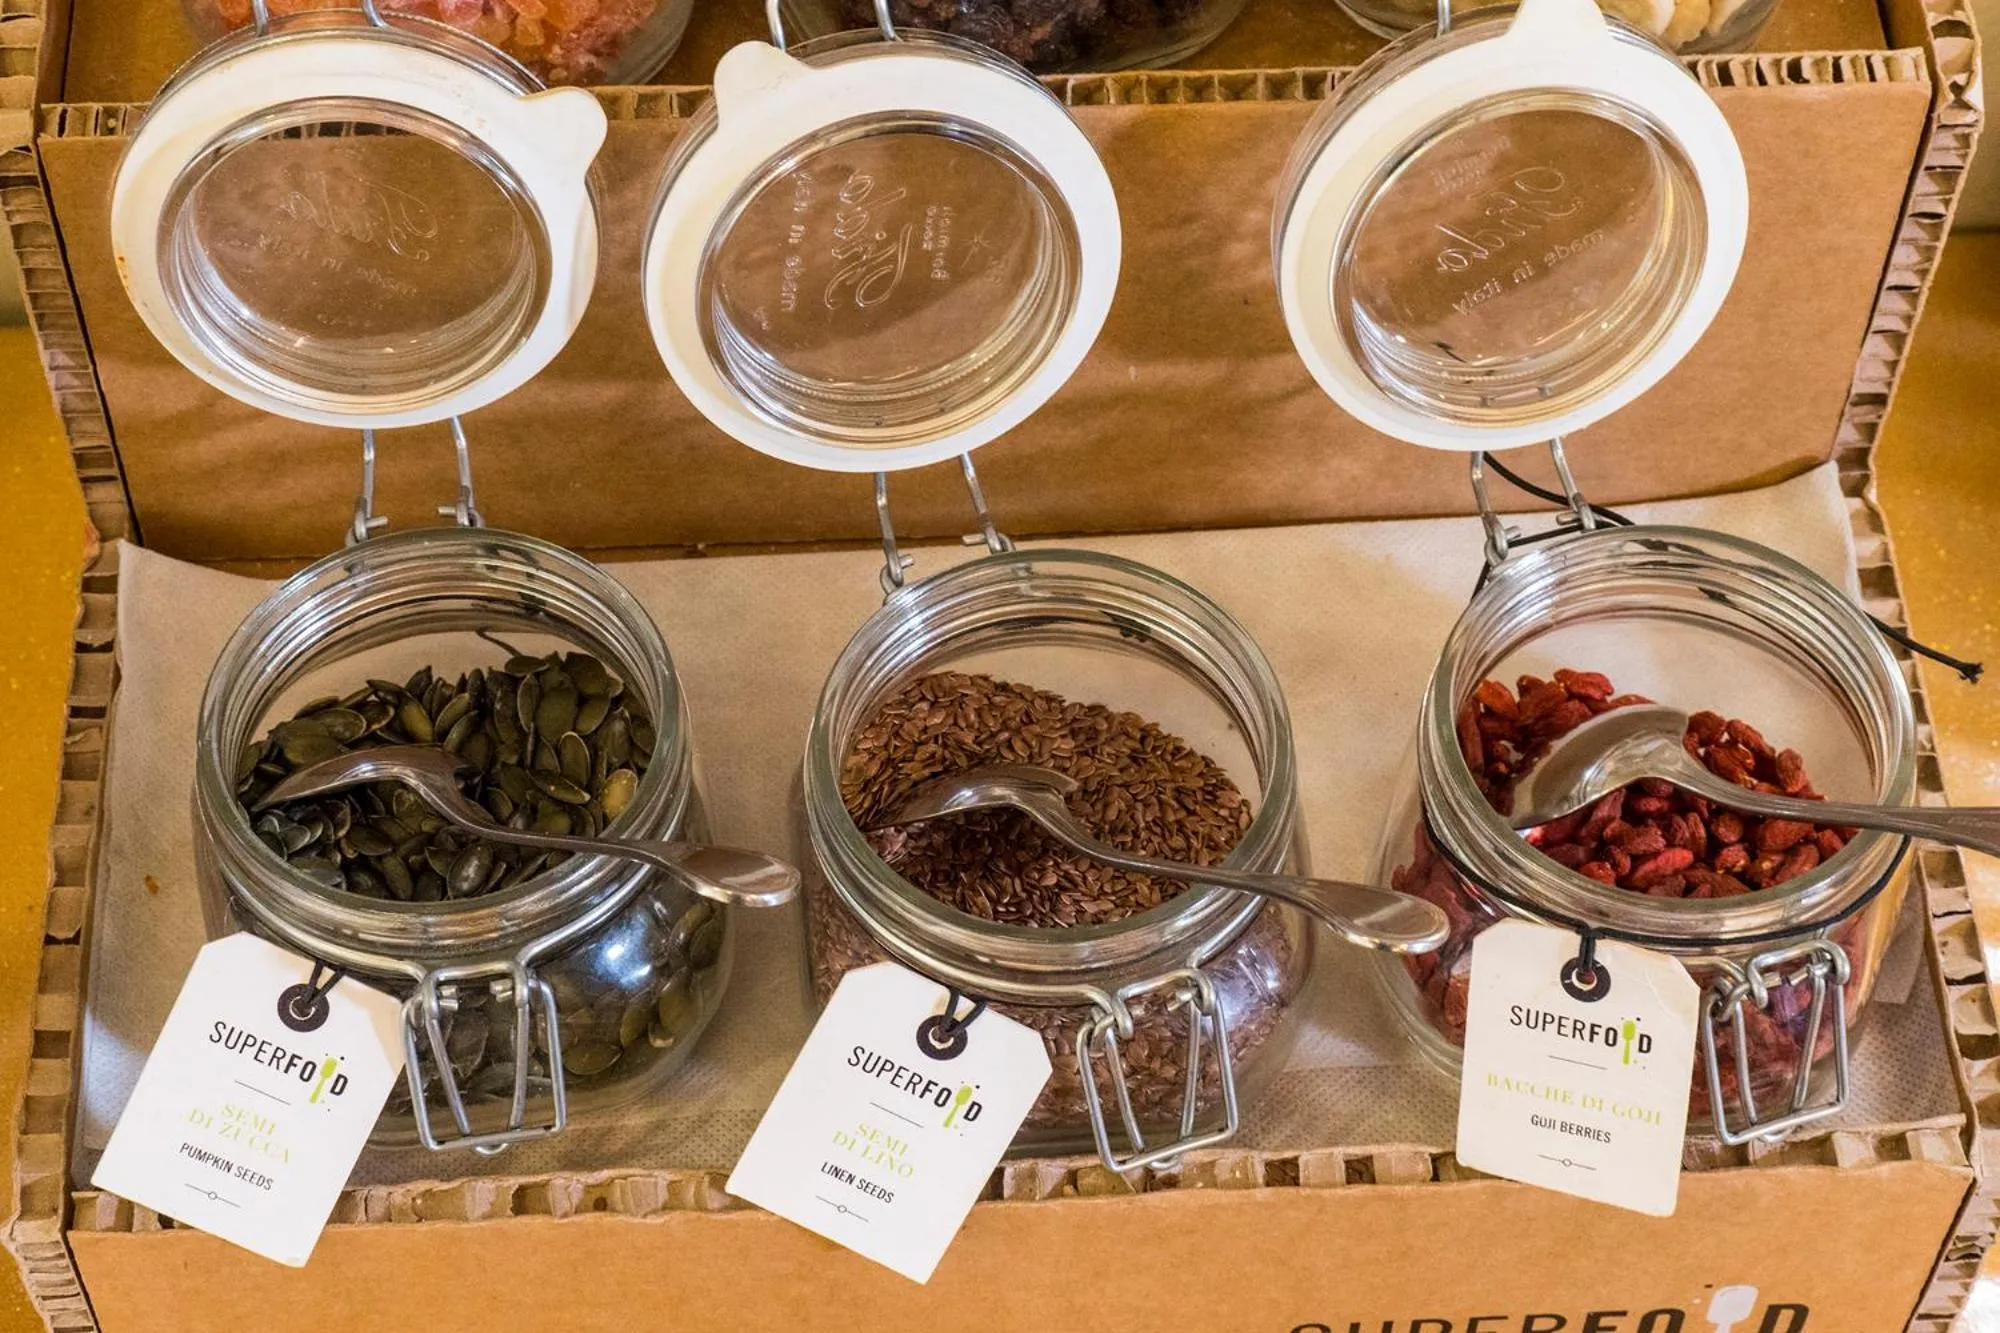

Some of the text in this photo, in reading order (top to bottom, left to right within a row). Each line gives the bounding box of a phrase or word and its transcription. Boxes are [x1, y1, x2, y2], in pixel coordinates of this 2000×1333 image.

[1487, 1071, 1575, 1106] BACCHE
[1580, 1093, 1605, 1114] DI
[187, 1106, 292, 1164] DI ZUCCA
[221, 1102, 277, 1136] SEMI
[855, 1119, 910, 1157] SEMI
[1560, 1120, 1612, 1144] BERRIES
[179, 1141, 275, 1192] PUMPKIN SEEDS
[831, 1129, 915, 1179] DI LINO
[820, 1161, 896, 1205] LINEN SEEDS
